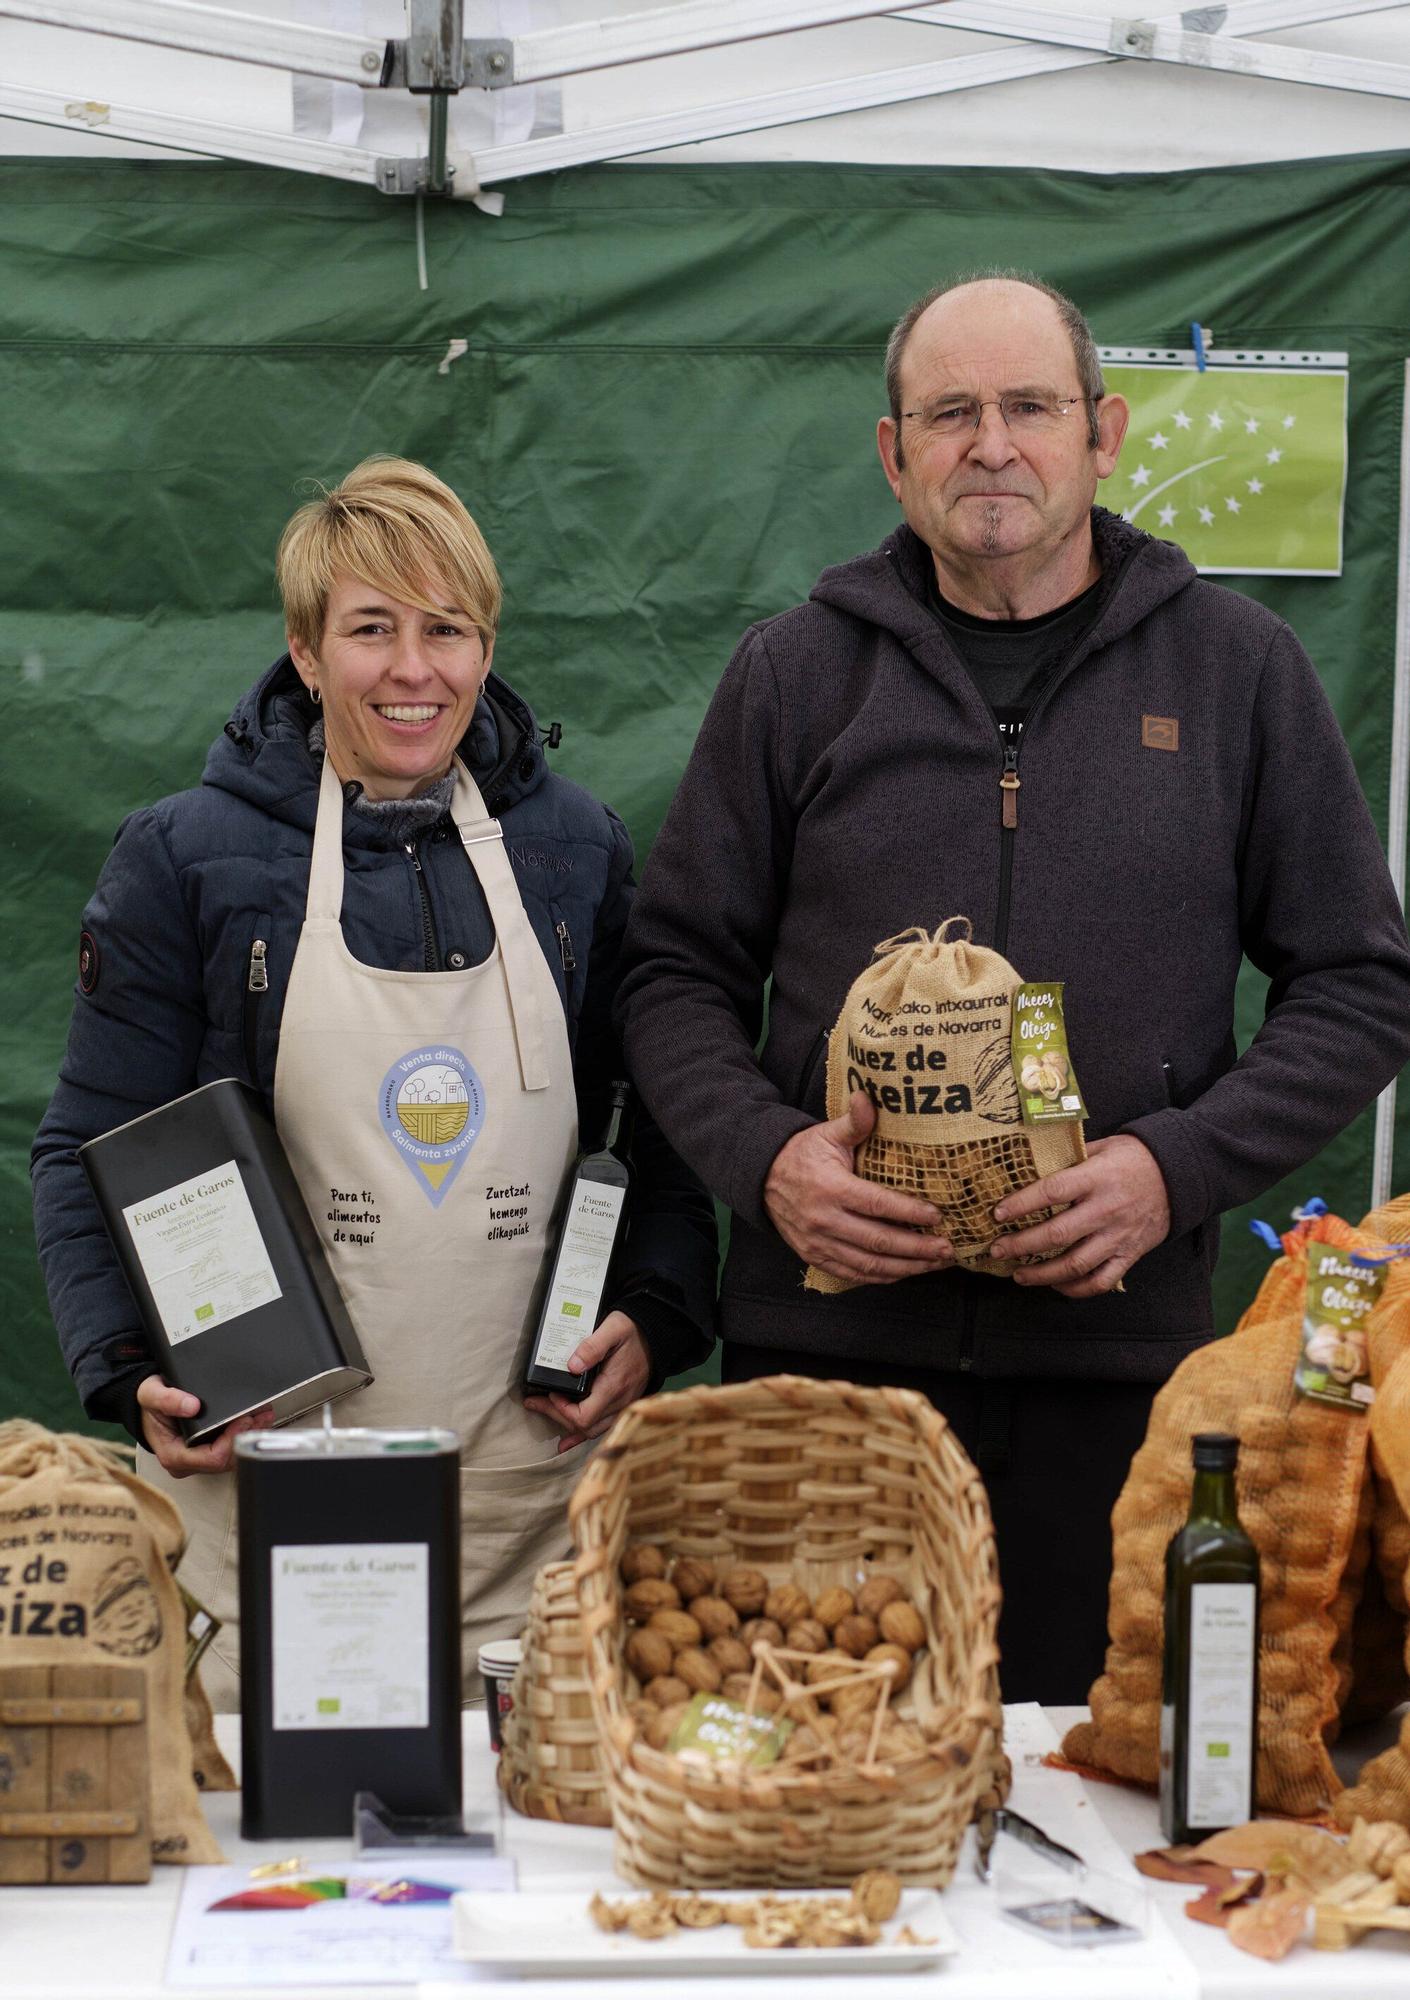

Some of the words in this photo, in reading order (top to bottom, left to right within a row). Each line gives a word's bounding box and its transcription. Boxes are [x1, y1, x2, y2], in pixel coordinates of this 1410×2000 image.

[935, 992, 1010, 1015] intxaurrak
[1017, 992, 1055, 1012] Nueces
[1034, 1009, 1046, 1020] de
[913, 1022, 935, 1036] de
[938, 1018, 1002, 1036] Navarra
[1020, 1020, 1057, 1040] Oteiza
[399, 1053, 432, 1073] Venta
[435, 1050, 466, 1072] directa
[905, 1044, 947, 1072] de
[391, 1128, 441, 1160] Salmenta
[444, 1128, 476, 1157] zuzena
[133, 1200, 178, 1226] Fuente
[179, 1193, 195, 1207] de
[197, 1175, 235, 1199] Garos
[330, 1188, 358, 1203] Para
[361, 1190, 375, 1205] ti,
[485, 1183, 531, 1200] Zuretzat,
[583, 1194, 612, 1209] Fuente
[327, 1209, 382, 1225] alimentos
[489, 1206, 528, 1220] hemengo
[578, 1205, 589, 1213] de
[590, 1207, 615, 1220] Garos
[333, 1229, 346, 1243] de
[349, 1231, 375, 1246] aquí
[487, 1222, 530, 1241] elikagaiak
[22, 1554, 69, 1585] de
[282, 1557, 340, 1575] Fuente
[342, 1557, 365, 1574] de
